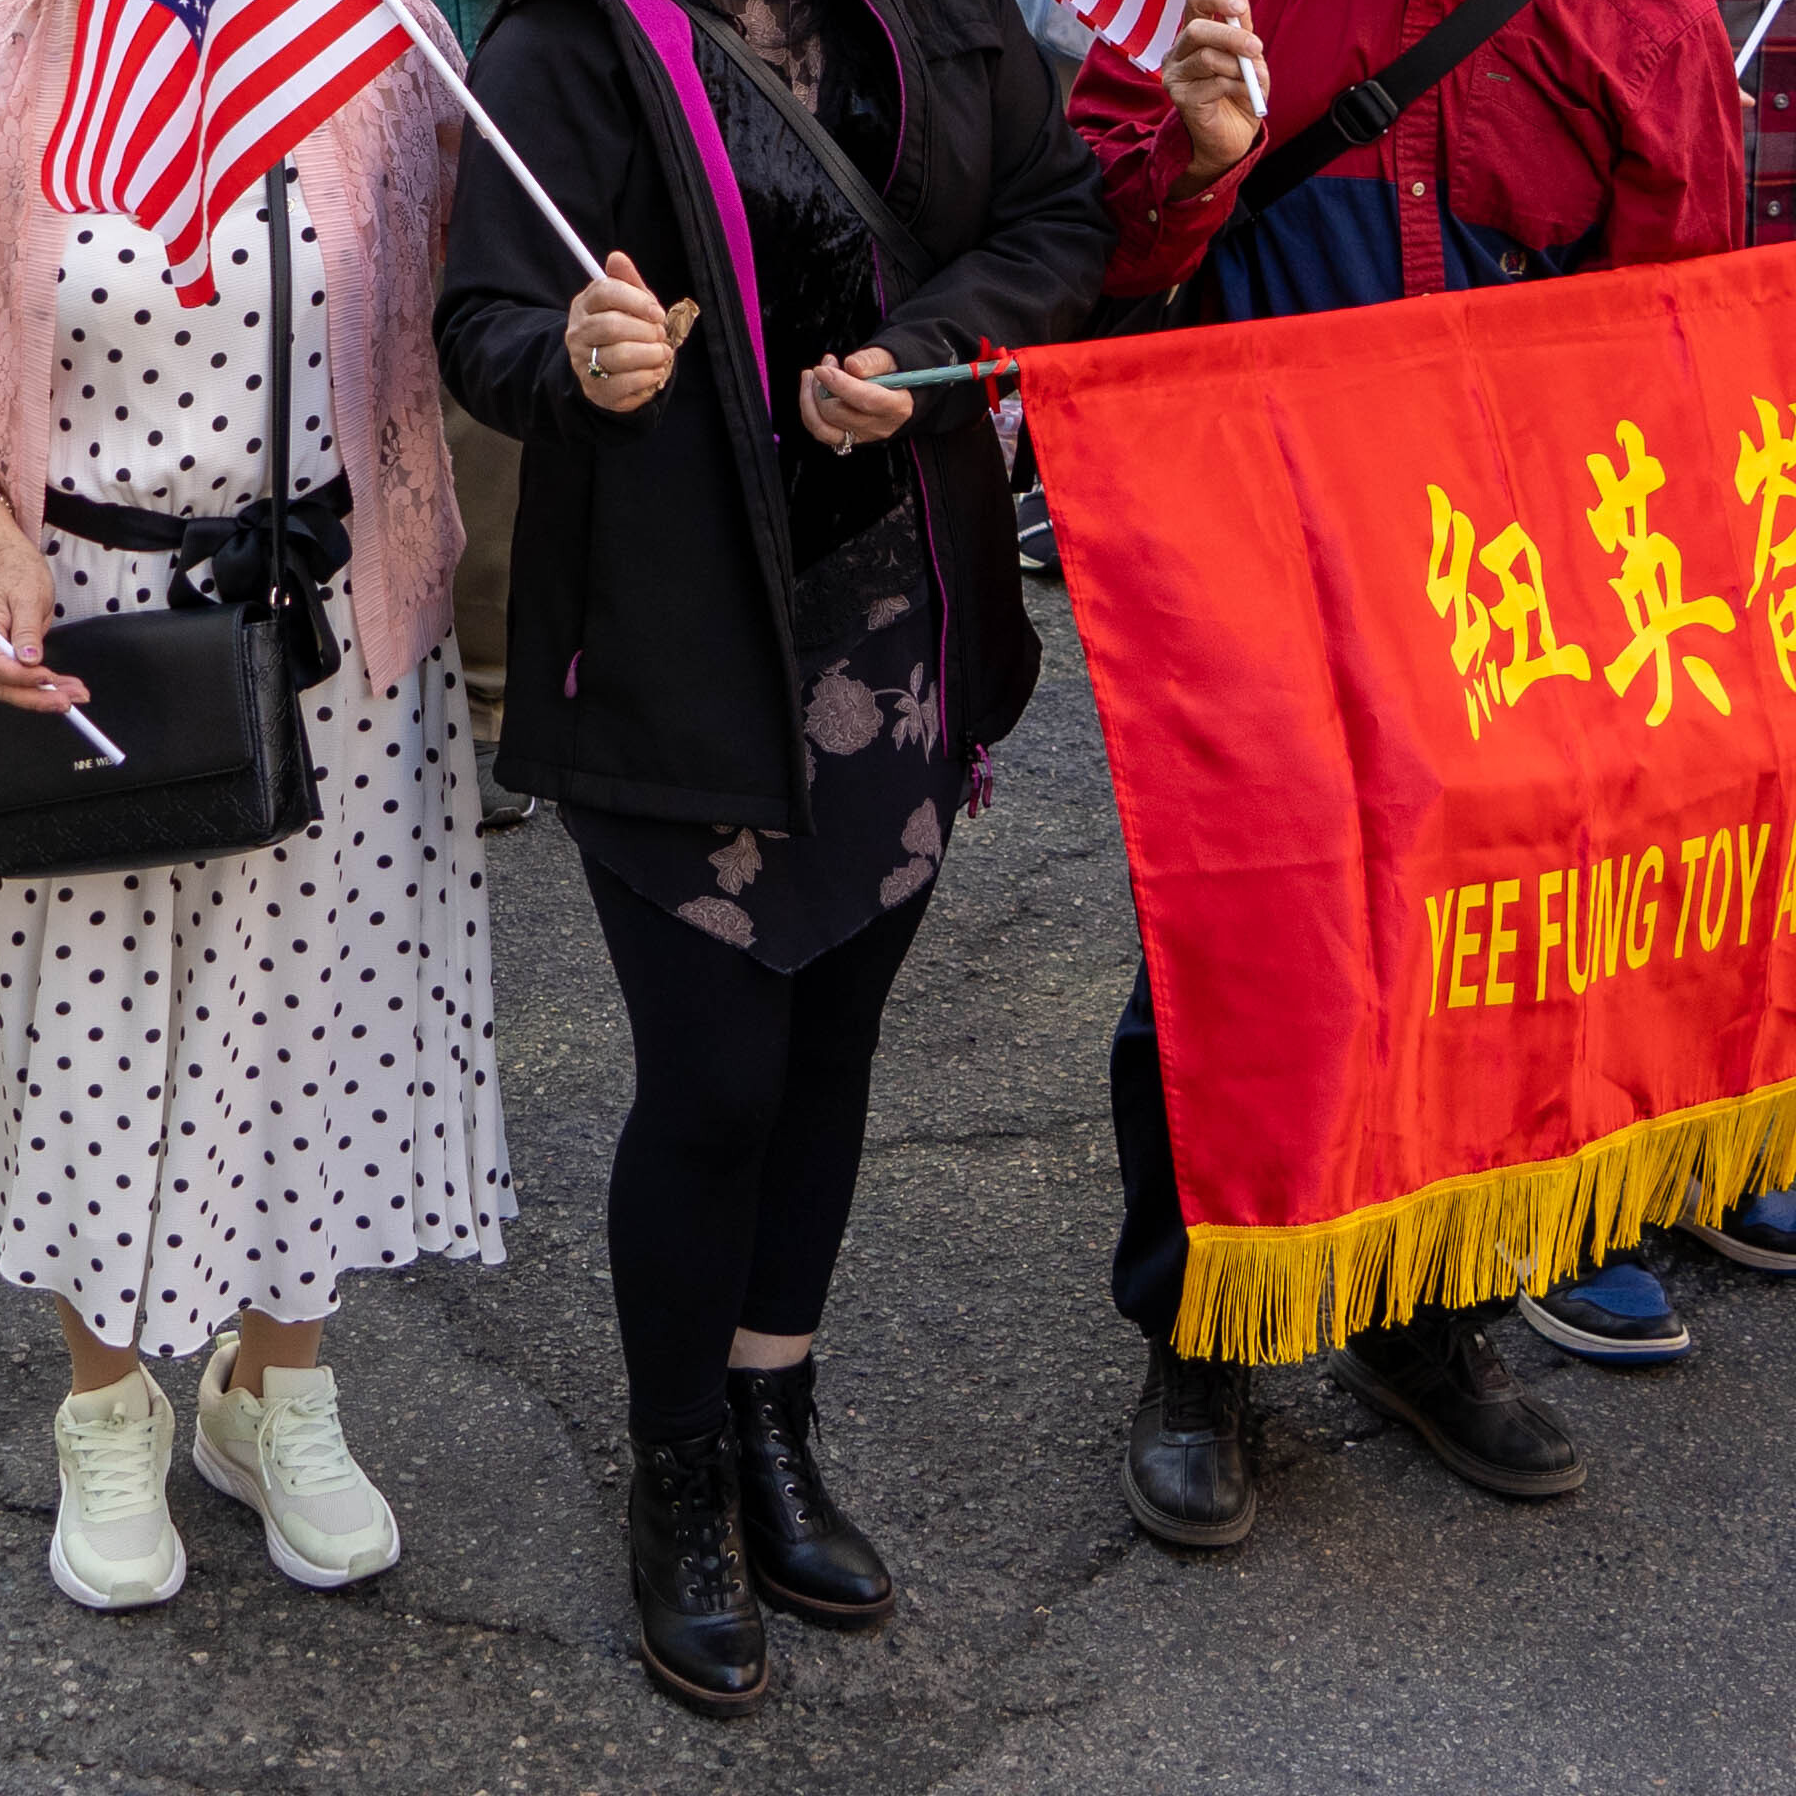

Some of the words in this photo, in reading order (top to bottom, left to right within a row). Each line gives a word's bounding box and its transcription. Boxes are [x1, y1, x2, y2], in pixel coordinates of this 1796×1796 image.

[1426, 879, 1520, 1017] YEE
[1536, 845, 1664, 1001] FUNG
[1674, 823, 1771, 959] TOY
